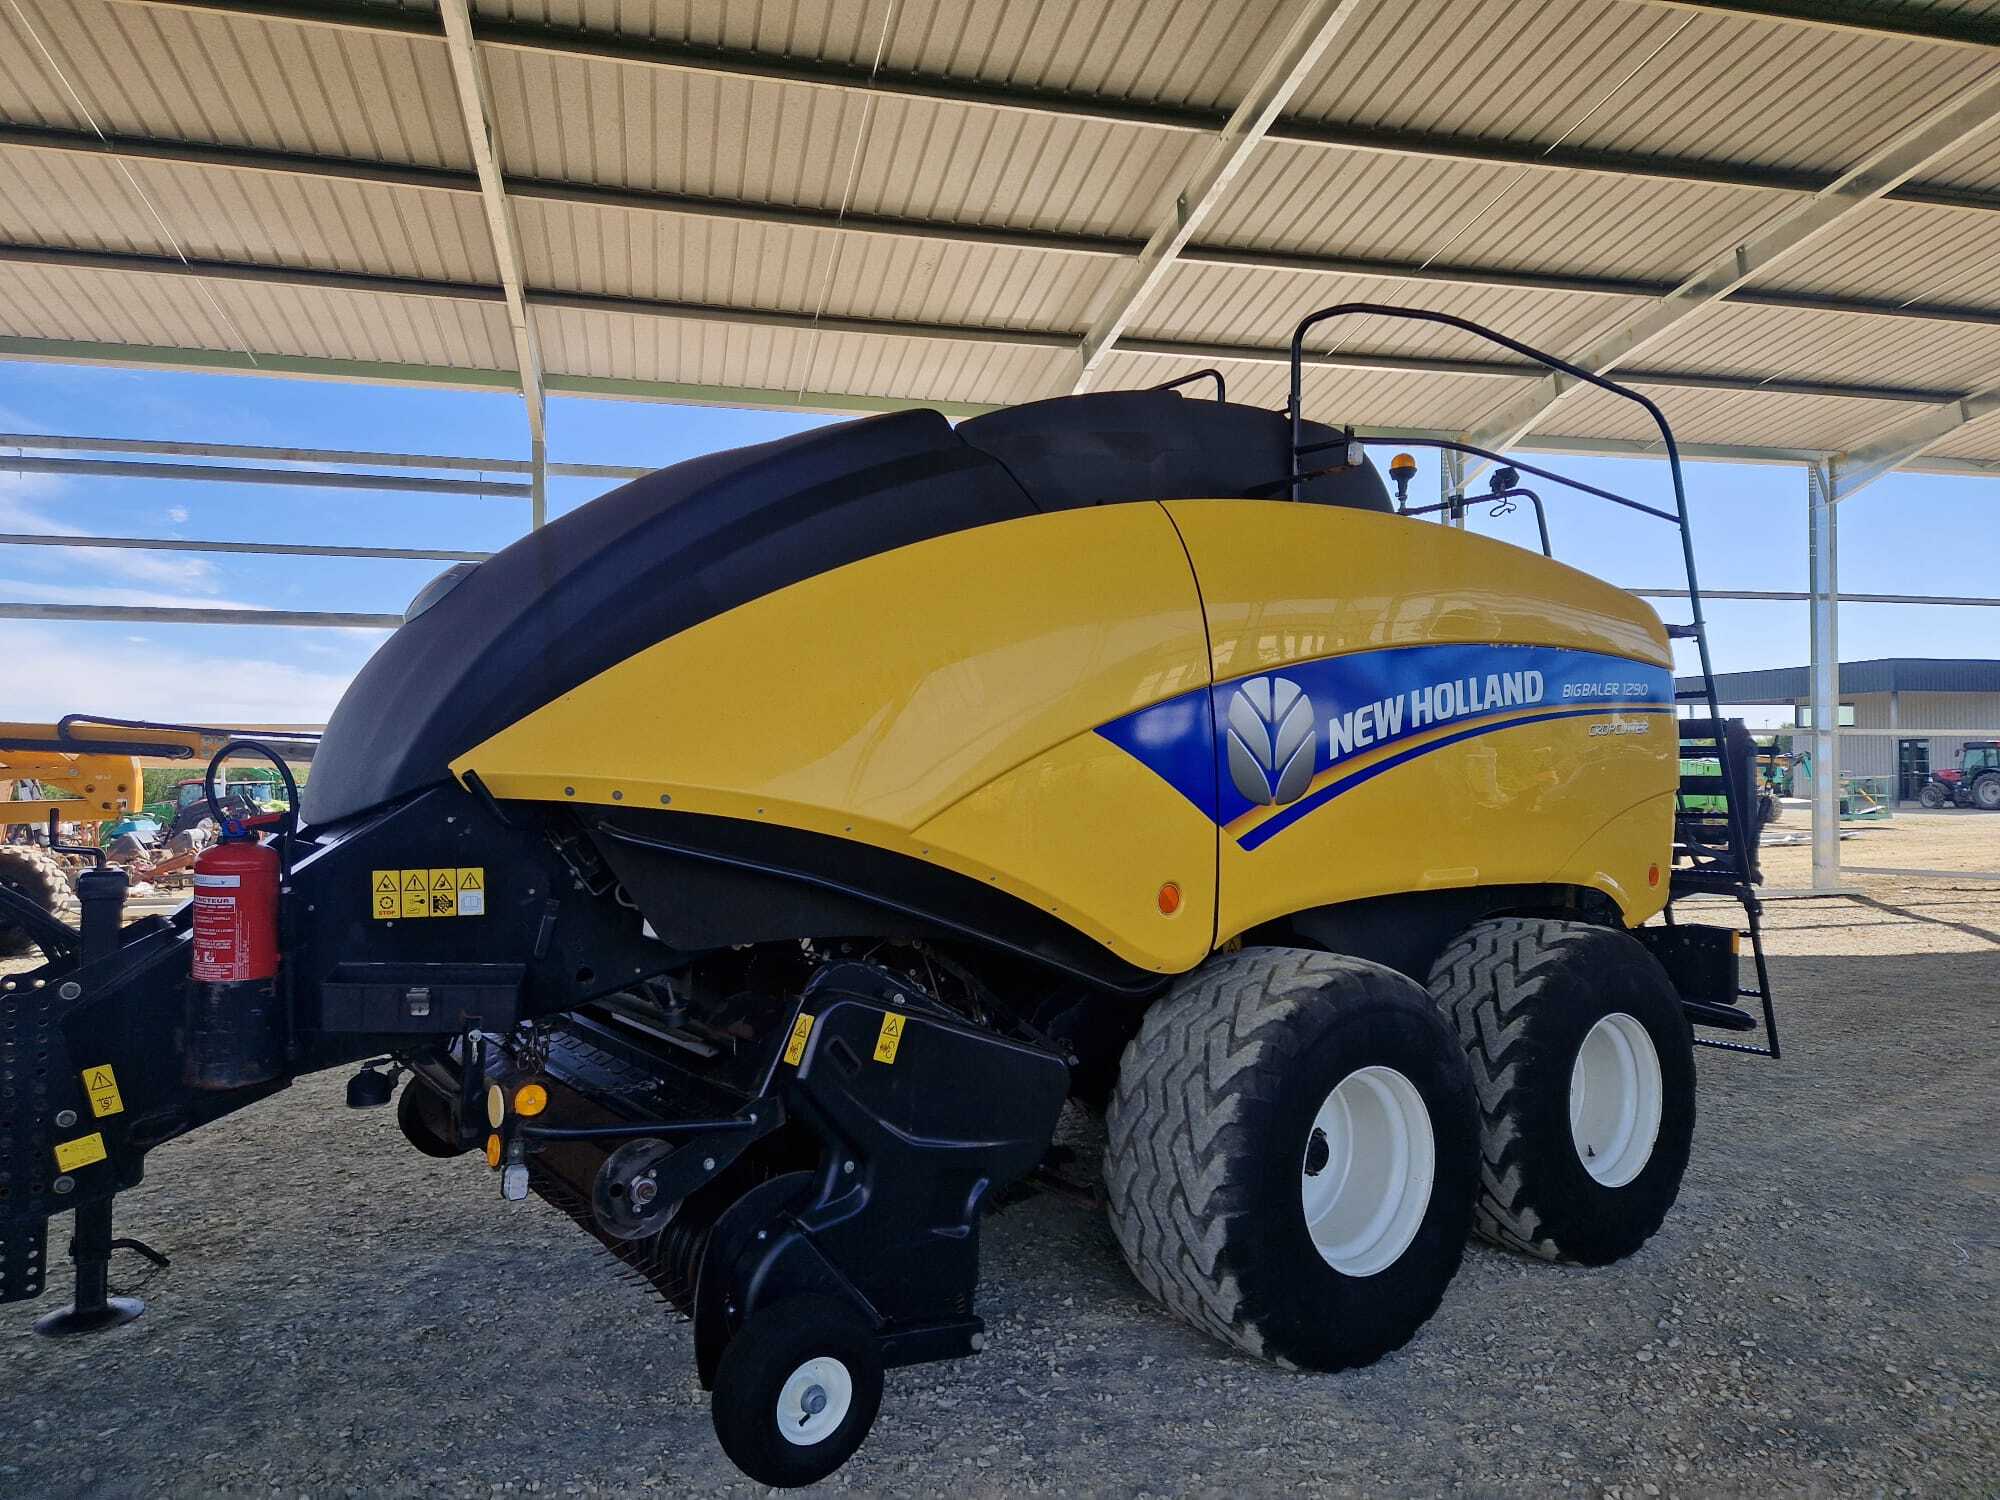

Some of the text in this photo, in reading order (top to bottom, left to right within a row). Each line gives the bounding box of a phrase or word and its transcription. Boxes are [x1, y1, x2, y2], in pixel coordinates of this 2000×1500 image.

[1329, 670, 1544, 760] NEW HOLLAND
[1562, 682, 1649, 698] BIGBALER 1290
